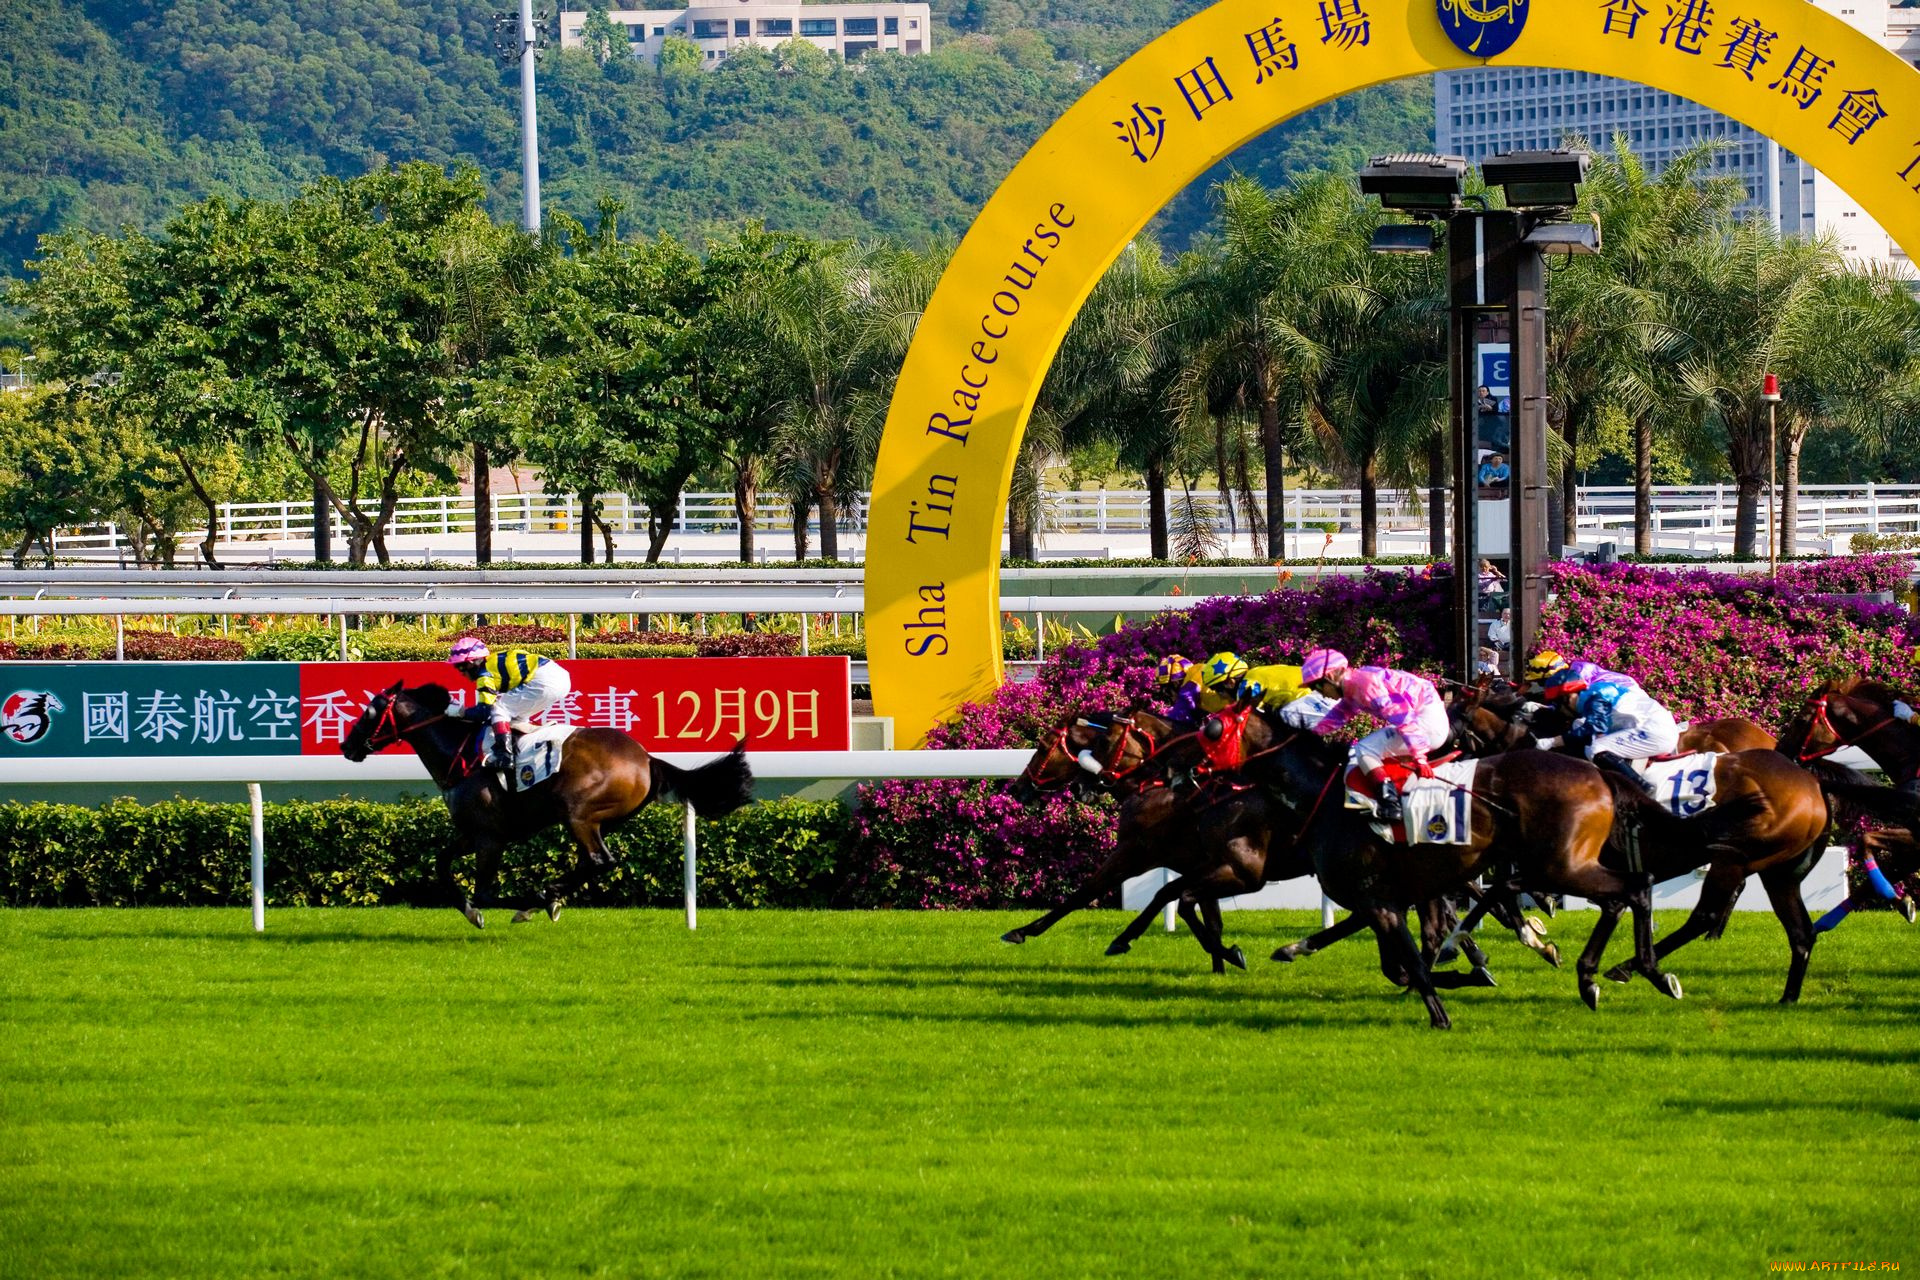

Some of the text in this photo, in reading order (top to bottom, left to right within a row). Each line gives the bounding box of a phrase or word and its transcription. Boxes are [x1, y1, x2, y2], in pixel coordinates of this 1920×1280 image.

[1111, 0, 1371, 165] 沙田馬場
[1598, 0, 1888, 146] 香港賽馬會
[904, 202, 1076, 657] Sha Tin Racecourse
[82, 688, 299, 744] 國泰航空
[653, 687, 819, 743] 12月9日
[1668, 769, 1710, 816] 13
